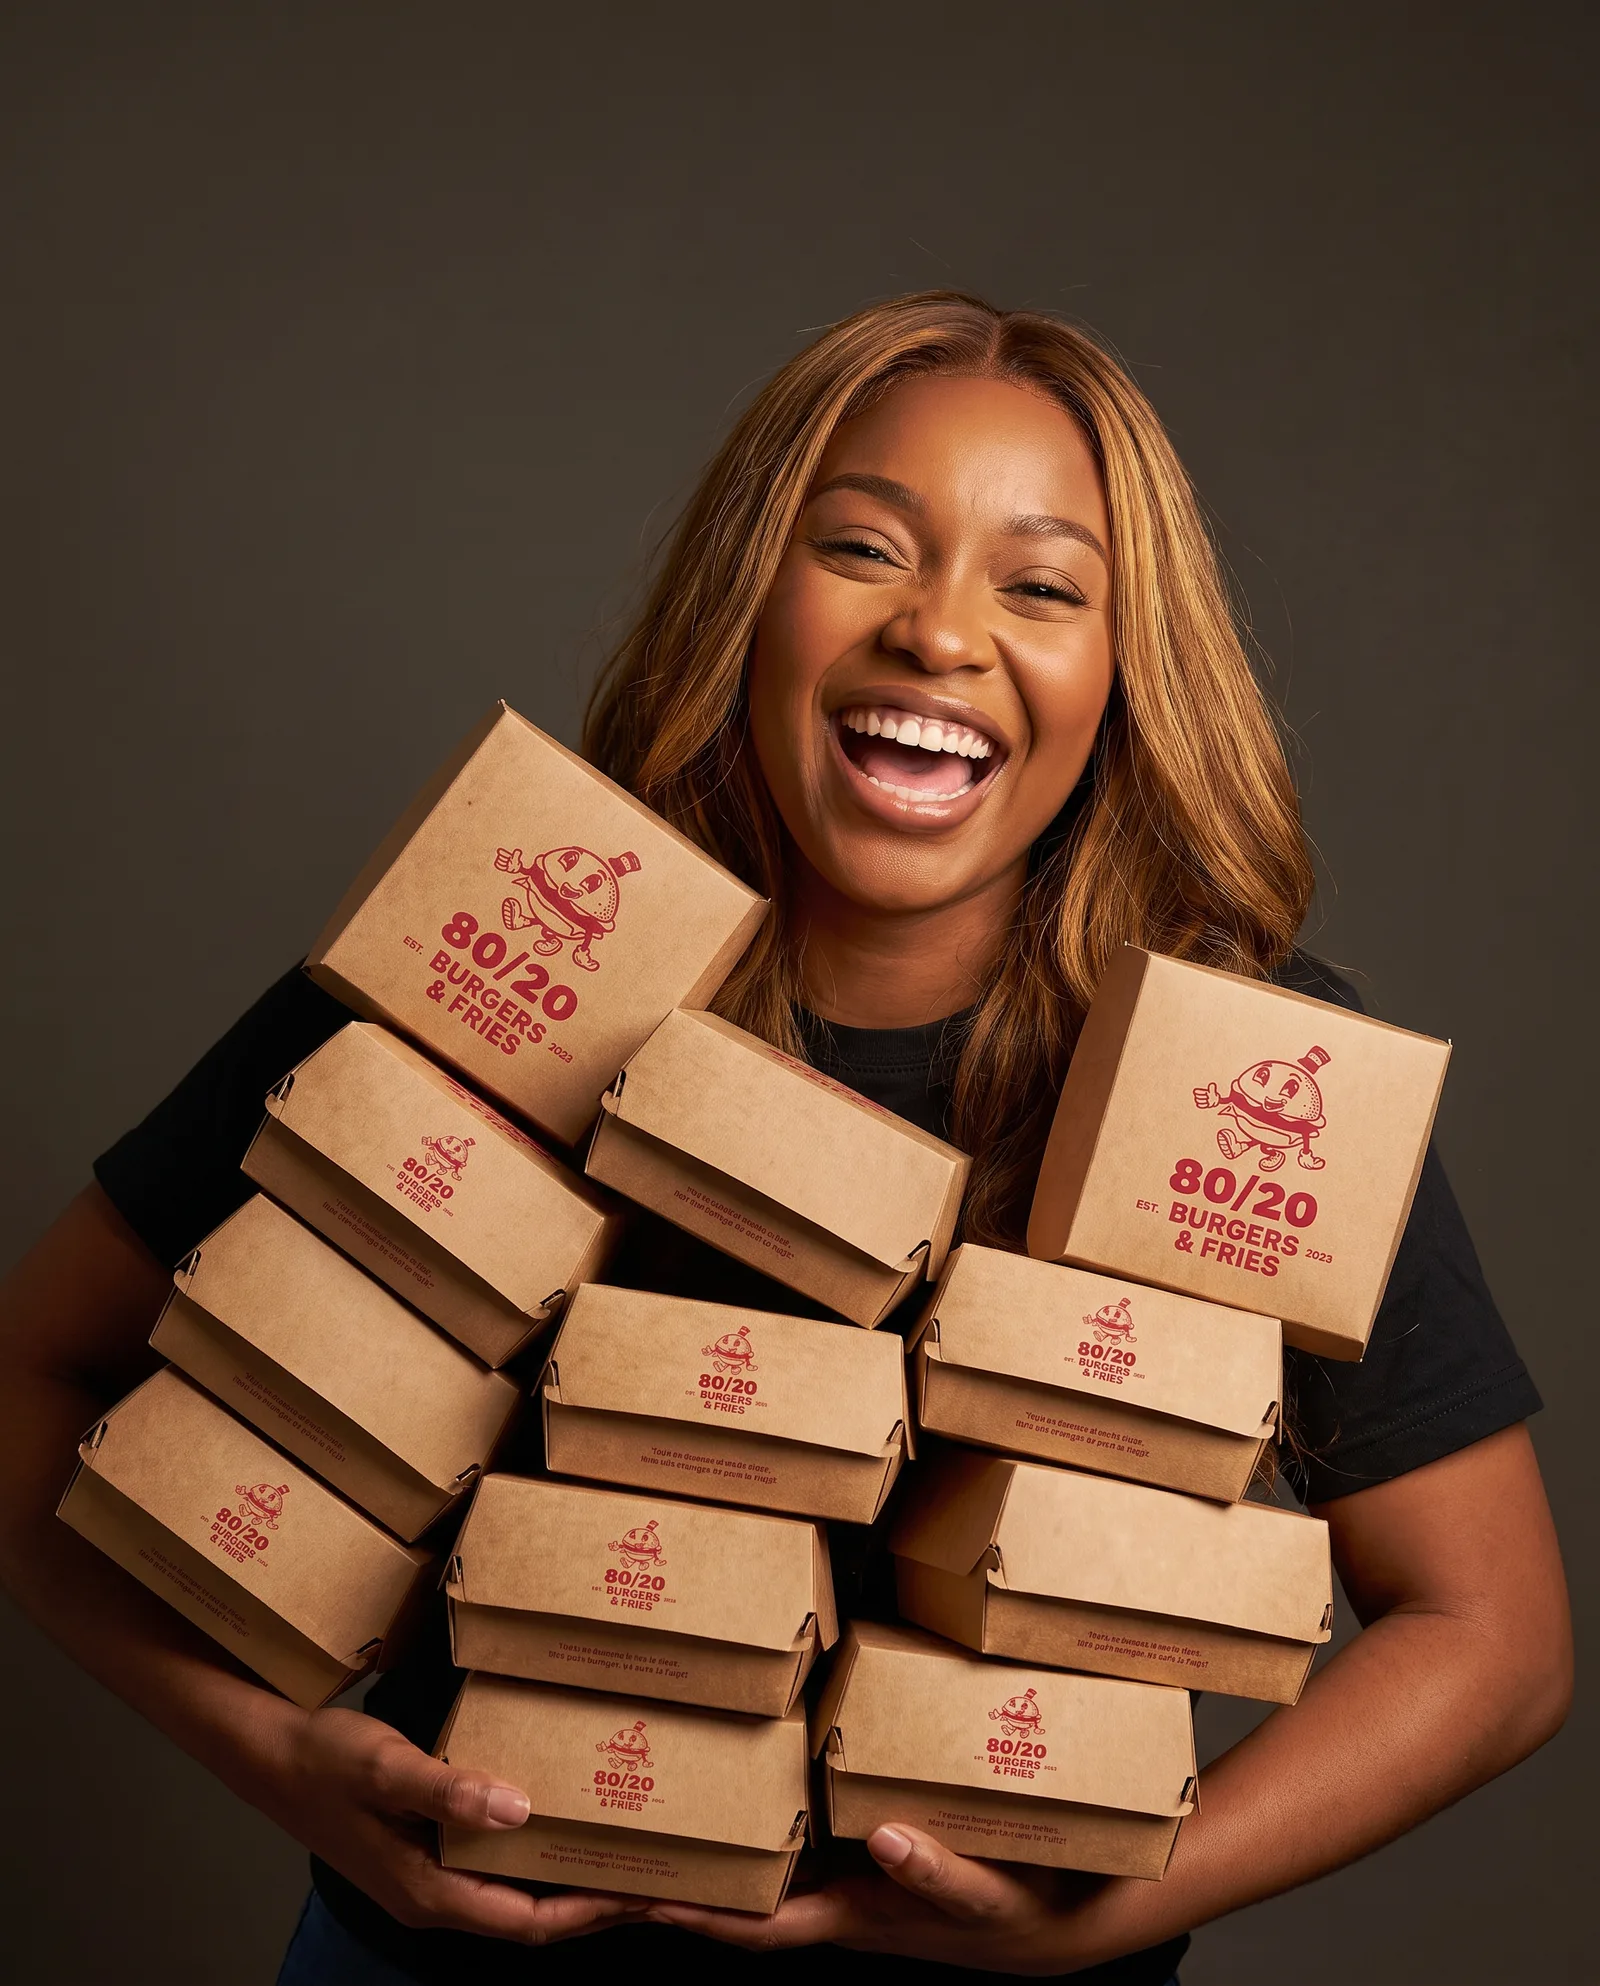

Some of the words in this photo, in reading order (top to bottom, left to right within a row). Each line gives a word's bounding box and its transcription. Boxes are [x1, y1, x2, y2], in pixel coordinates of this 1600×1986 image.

[403, 935, 423, 954] EST.
[441, 911, 578, 1021] 80/20
[429, 950, 547, 1043] BURGERS
[426, 980, 445, 1003] &
[447, 994, 521, 1055] FRIES
[548, 1043, 573, 1064] 2023
[403, 1158, 453, 1199] 80/20
[404, 1188, 432, 1212] FRIES
[1169, 1158, 1318, 1227] 80/20
[1136, 1200, 1159, 1213] EST.
[1169, 1202, 1300, 1256] BURGERS
[1174, 1230, 1193, 1253] &
[1200, 1238, 1280, 1277] FRIES
[1305, 1249, 1333, 1264] 2023
[1078, 1342, 1136, 1366] 80/20
[1079, 1358, 1130, 1376] BURGERS
[1083, 1368, 1090, 1376] &
[1093, 1371, 1123, 1384] FRIES
[699, 1374, 757, 1395] 80/20
[700, 1391, 752, 1405] BURGERS
[704, 1401, 711, 1409] &
[714, 1402, 745, 1414] FRIES
[216, 1508, 268, 1550] 80/20
[605, 1569, 665, 1590] 80/20
[607, 1586, 660, 1602] BURGERS
[611, 1597, 618, 1605] &
[621, 1599, 652, 1611] FRIES
[986, 1738, 1046, 1758] 80/20
[989, 1755, 1040, 1769] BURGERS
[993, 1765, 1000, 1774] &
[1004, 1767, 1034, 1779] FRIES
[594, 1770, 654, 1791] 80/20
[596, 1788, 648, 1802] BURGERS
[600, 1798, 607, 1806] &
[611, 1800, 642, 1811] FRIES
